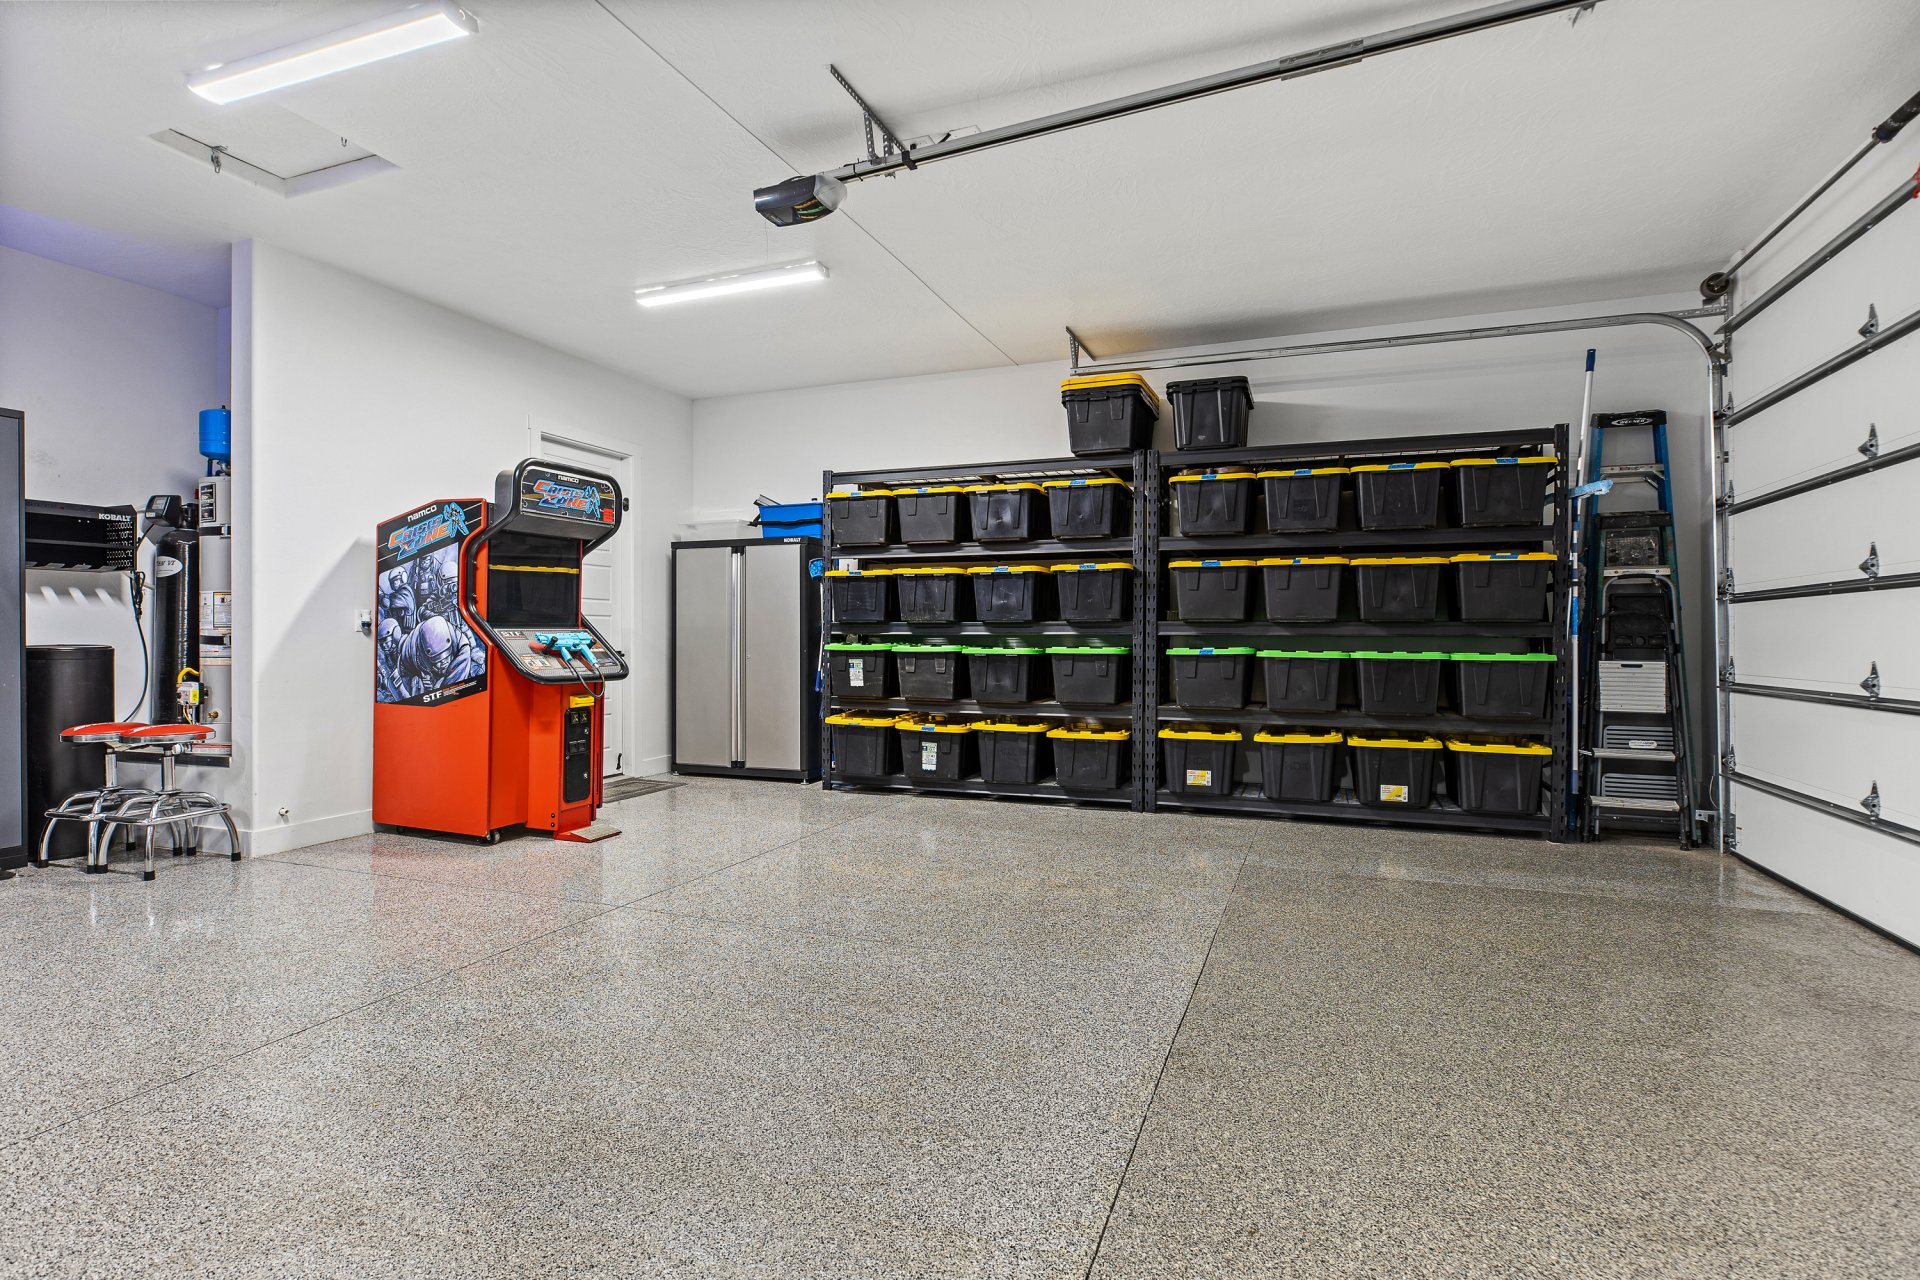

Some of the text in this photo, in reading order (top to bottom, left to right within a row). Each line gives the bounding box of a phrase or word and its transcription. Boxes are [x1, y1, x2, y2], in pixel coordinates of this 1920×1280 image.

[557, 475, 580, 483] namco
[98, 513, 131, 521] KOBALT
[407, 504, 437, 522] namco
[422, 690, 443, 703] STF
